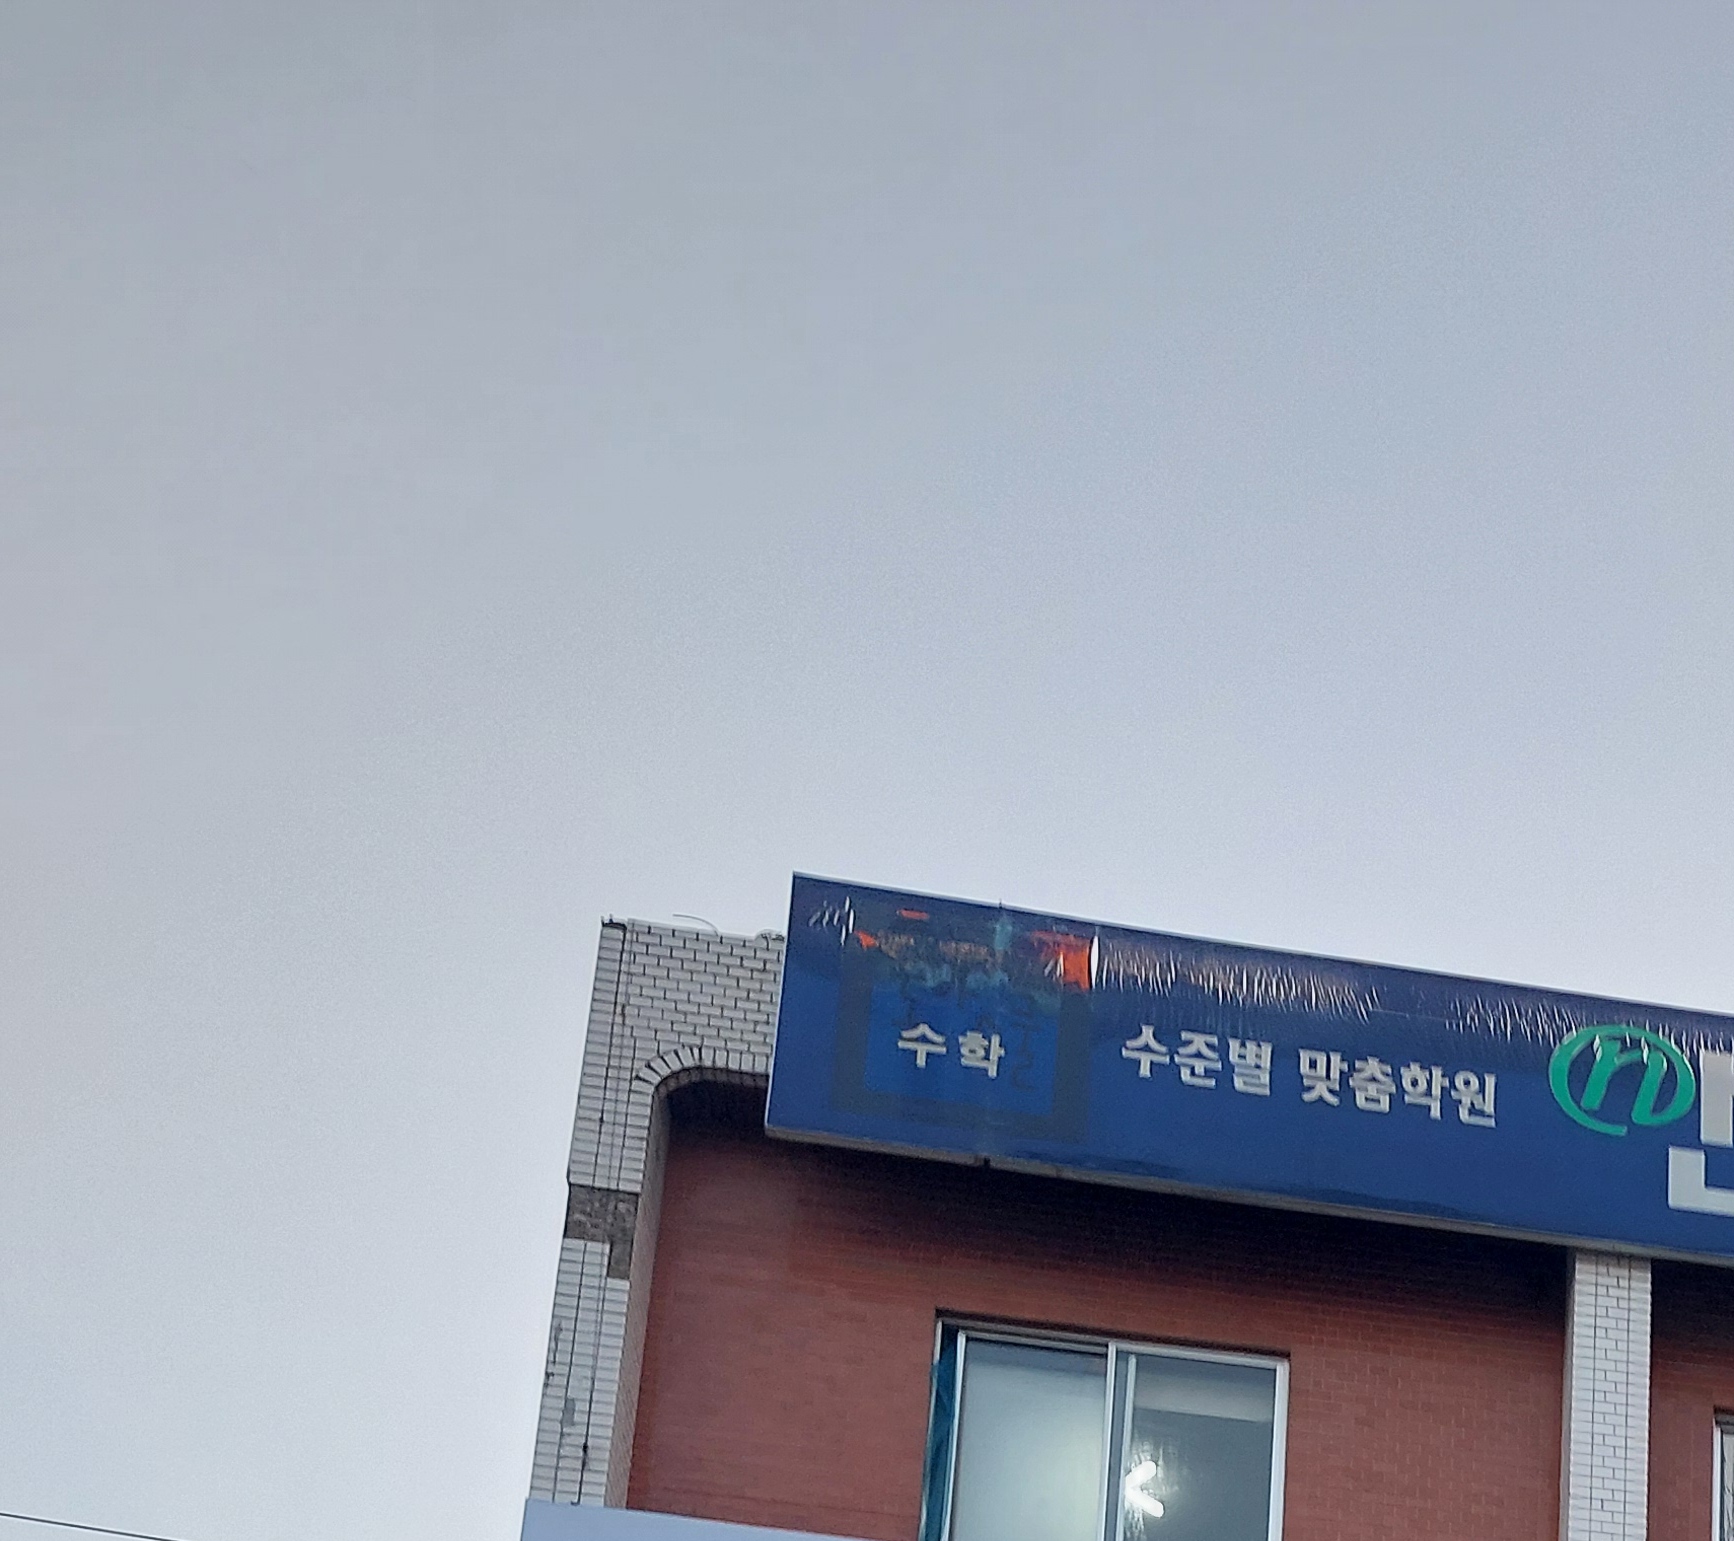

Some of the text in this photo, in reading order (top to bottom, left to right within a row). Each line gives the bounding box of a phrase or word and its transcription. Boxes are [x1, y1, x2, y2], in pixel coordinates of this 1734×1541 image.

[896, 1019, 1007, 1080] 수학
[1120, 1021, 1499, 1129] 수준별 맞춤학원
